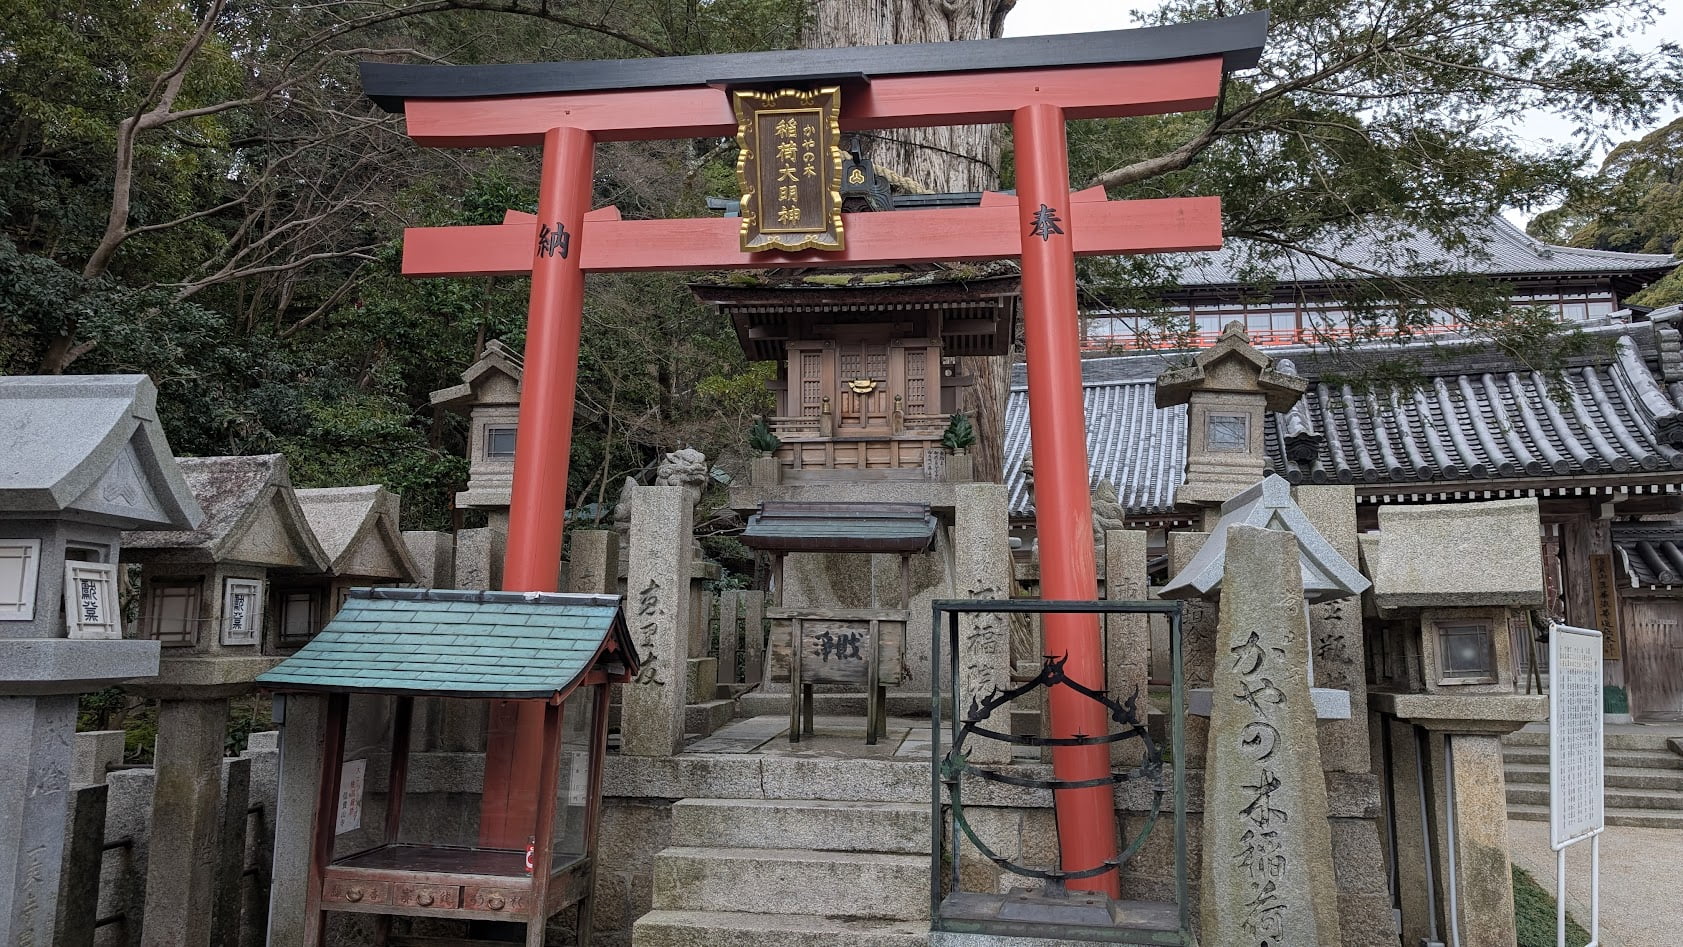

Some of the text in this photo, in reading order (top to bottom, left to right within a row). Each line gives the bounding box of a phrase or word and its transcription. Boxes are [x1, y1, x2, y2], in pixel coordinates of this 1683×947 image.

[774, 117, 801, 226] 稲荷大明神
[801, 124, 817, 178] かやの木
[537, 221, 571, 260] 納
[1029, 203, 1064, 242] 奉
